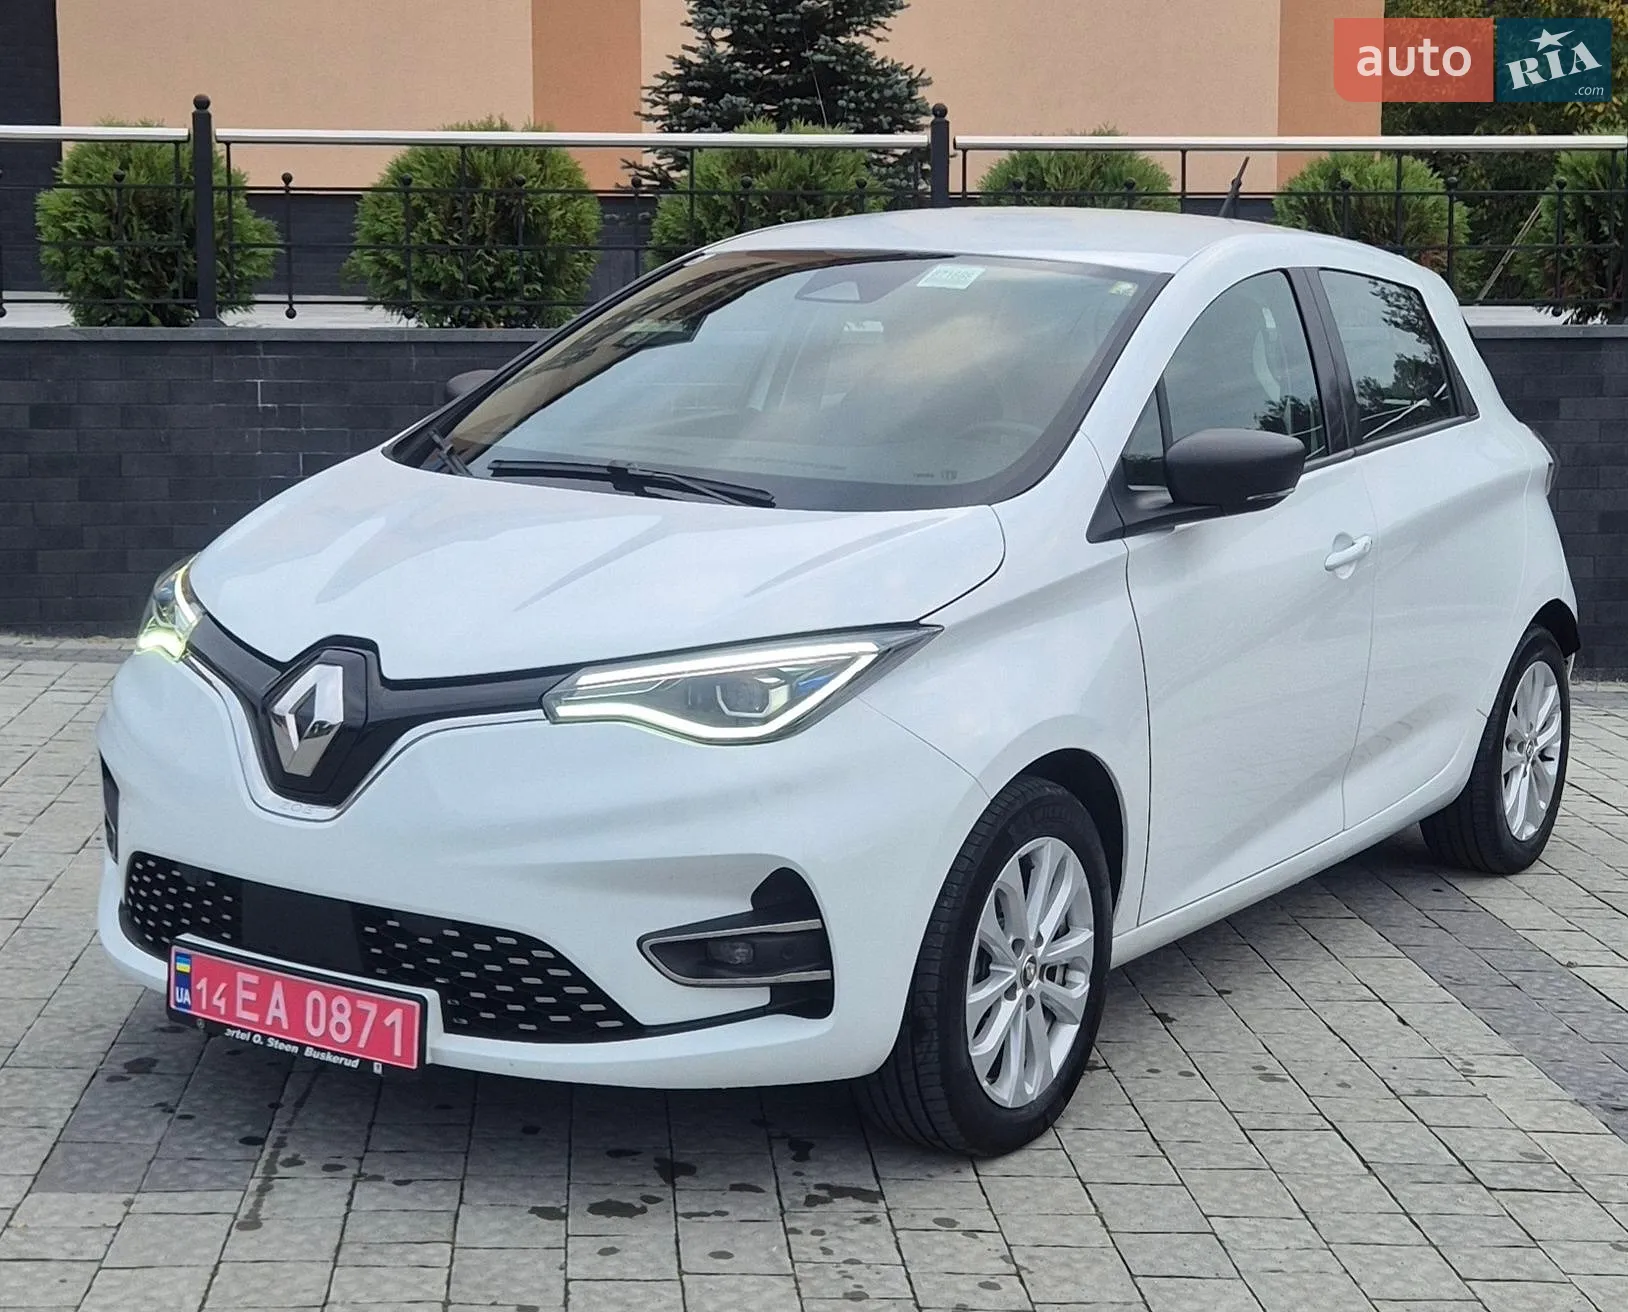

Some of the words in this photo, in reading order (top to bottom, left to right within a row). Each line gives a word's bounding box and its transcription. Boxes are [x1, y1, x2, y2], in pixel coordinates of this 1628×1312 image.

[176, 986, 191, 1006] UA
[305, 990, 404, 1058] 0871
[266, 1037, 299, 1055] Steen
[304, 1046, 360, 1070] Buskerud
